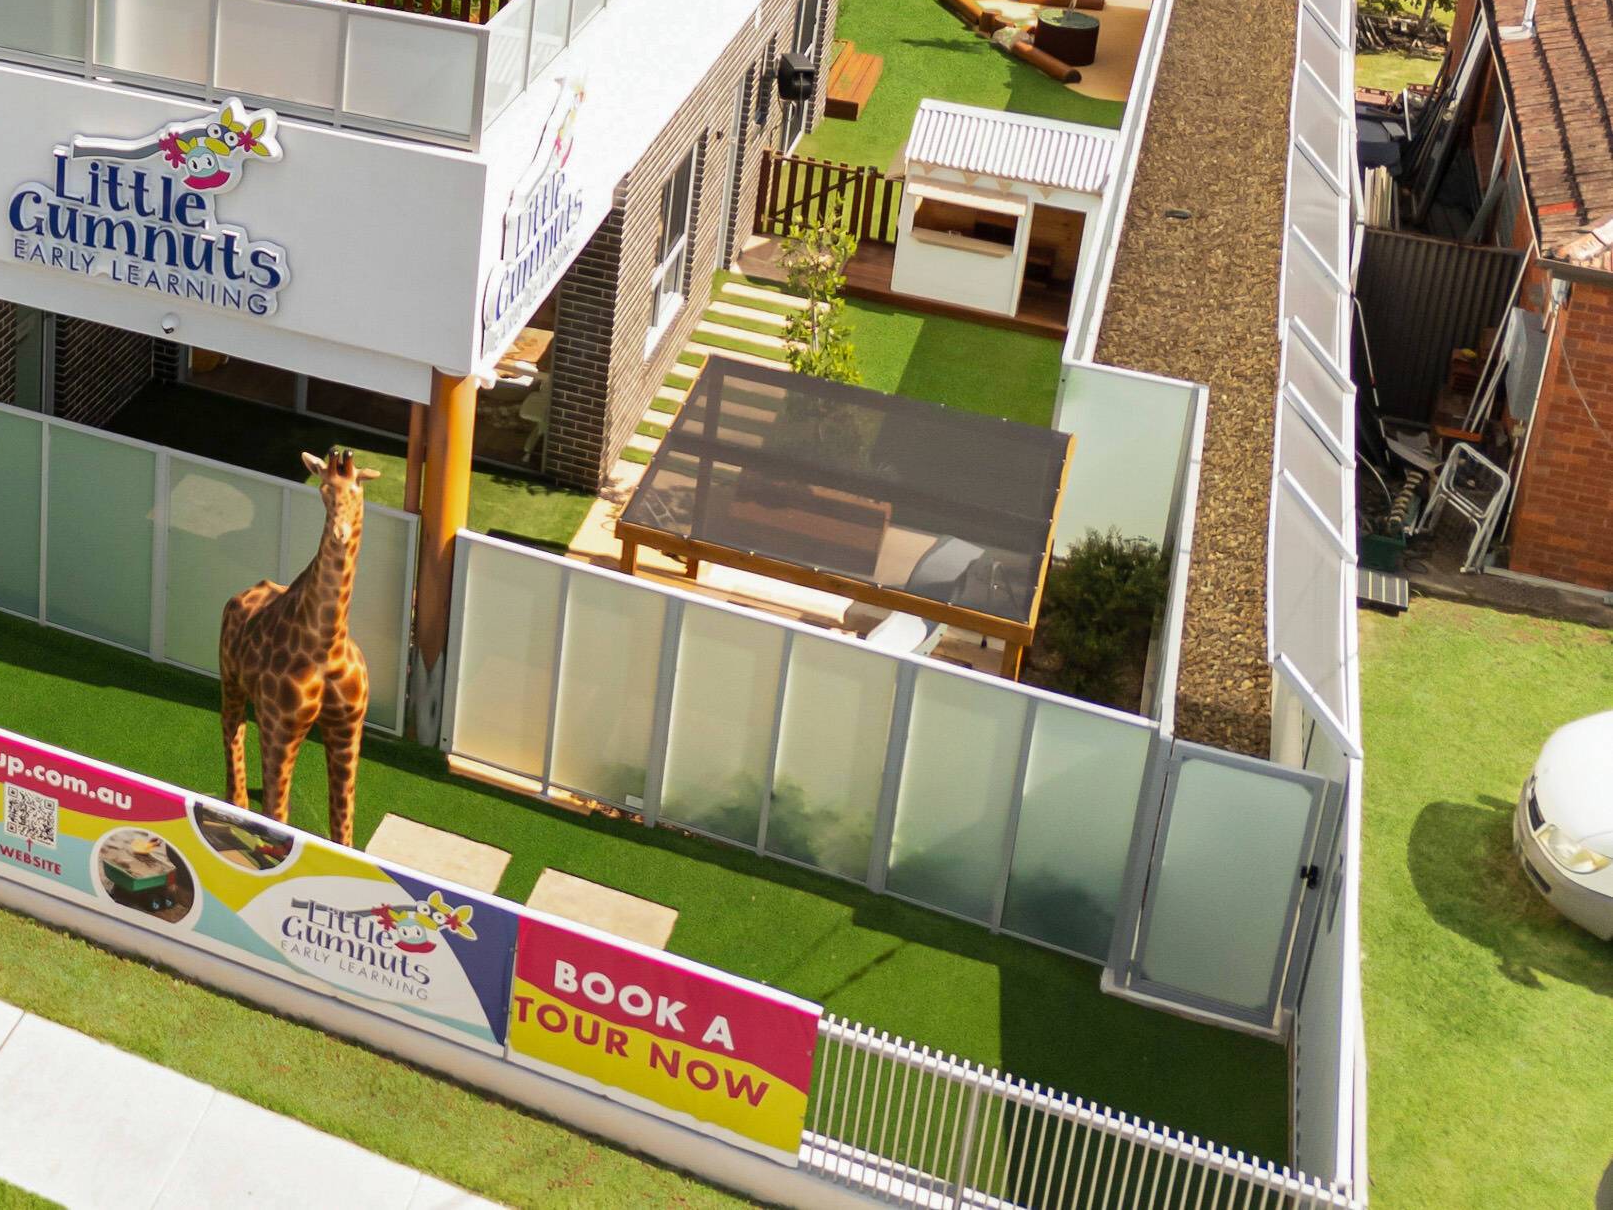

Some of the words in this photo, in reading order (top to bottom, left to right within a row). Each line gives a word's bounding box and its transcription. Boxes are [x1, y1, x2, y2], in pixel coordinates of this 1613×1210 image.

[54, 152, 207, 228] Little
[515, 171, 566, 258] Little
[9, 190, 281, 290] Gumnuts
[14, 238, 95, 274] EARLY
[112, 260, 269, 315] LEARNING
[495, 188, 583, 321] Gumnuts
[0, 843, 62, 876] WEBSITE
[281, 915, 431, 986] Gumnuts
[308, 899, 394, 950] Little
[281, 940, 331, 964] EARLY
[339, 959, 429, 1001] LEARNING
[554, 958, 687, 1033] BOOK
[701, 1014, 735, 1052] A
[514, 995, 629, 1058] TOUR
[649, 1041, 770, 1108] NOW
